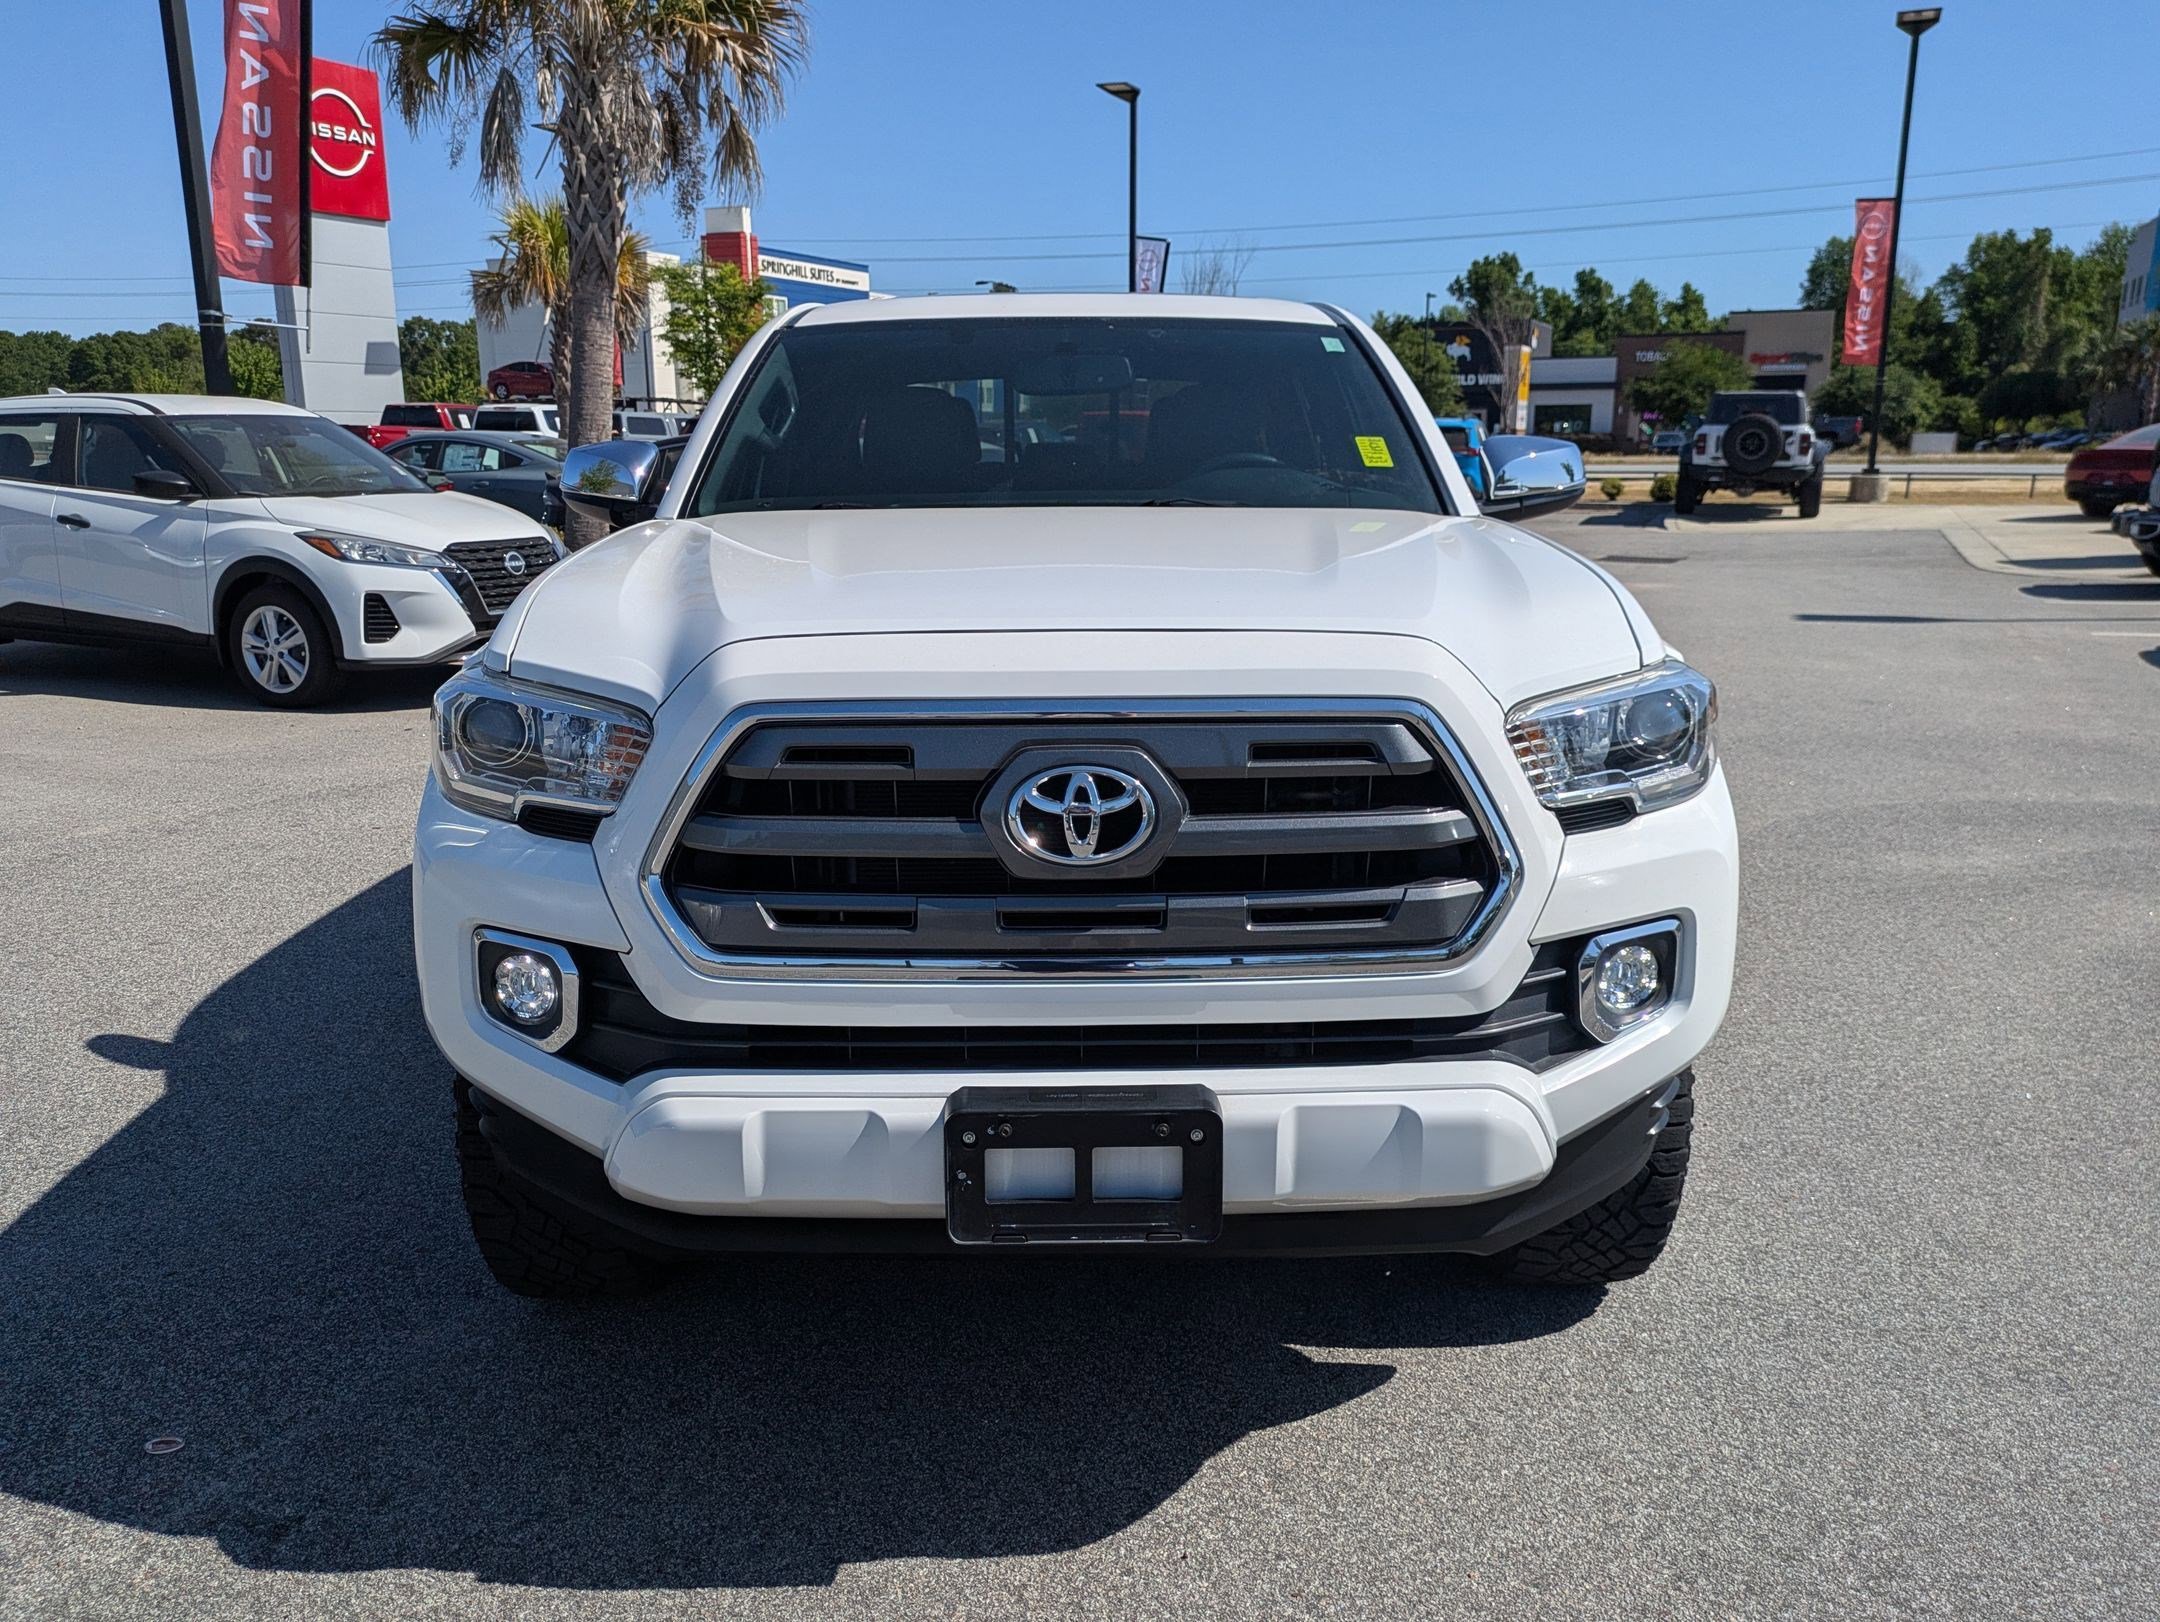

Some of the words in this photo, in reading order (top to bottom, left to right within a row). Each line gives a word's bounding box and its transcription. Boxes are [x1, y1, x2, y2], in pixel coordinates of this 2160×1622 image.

[311, 121, 376, 147] ISSAN
[761, 259, 808, 279] SPRINGHILL
[809, 267, 835, 283] SUITES
